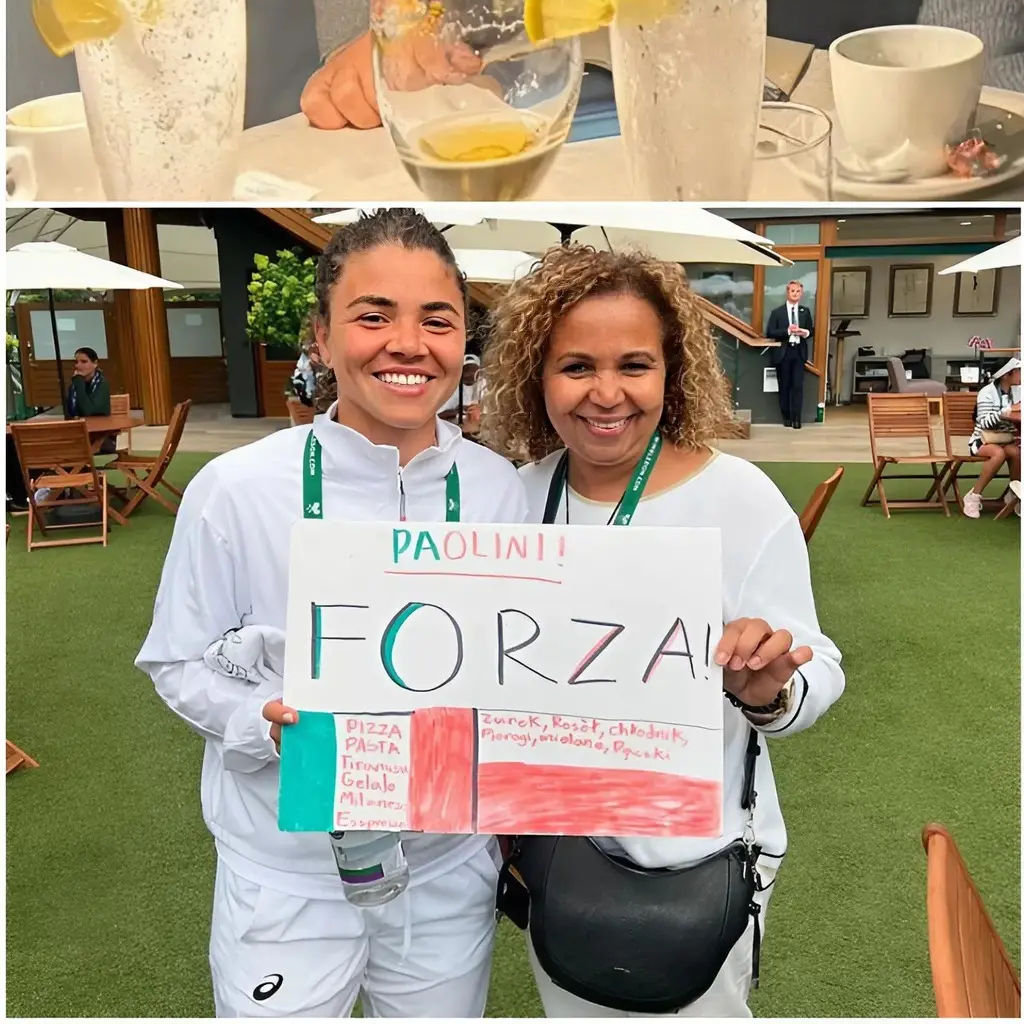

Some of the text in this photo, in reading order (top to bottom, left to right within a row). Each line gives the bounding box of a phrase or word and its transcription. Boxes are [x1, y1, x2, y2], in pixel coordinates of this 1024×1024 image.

[392, 528, 566, 567] PAOLINI!
[310, 601, 711, 693] FORZA!
[346, 718, 403, 740] PIZZA
[344, 736, 401, 755] PASTA
